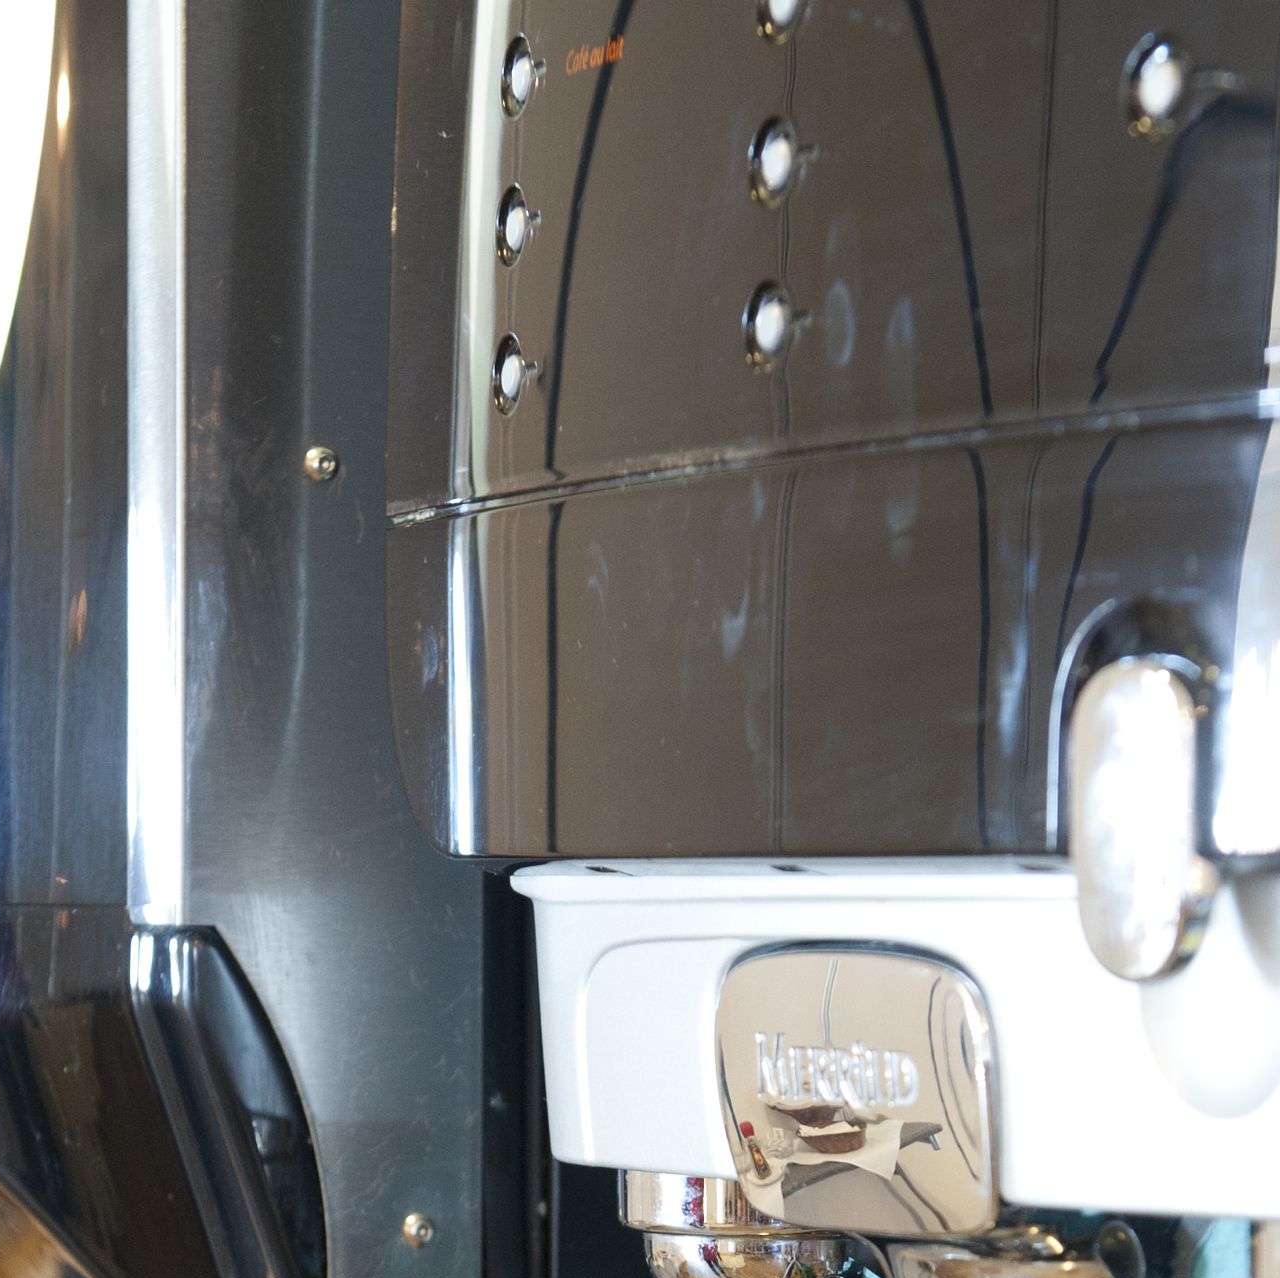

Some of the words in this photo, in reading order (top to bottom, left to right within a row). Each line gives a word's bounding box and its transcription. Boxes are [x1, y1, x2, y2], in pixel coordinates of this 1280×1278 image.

[566, 43, 589, 76] Café
[590, 46, 604, 69] au
[605, 34, 625, 64] lait
